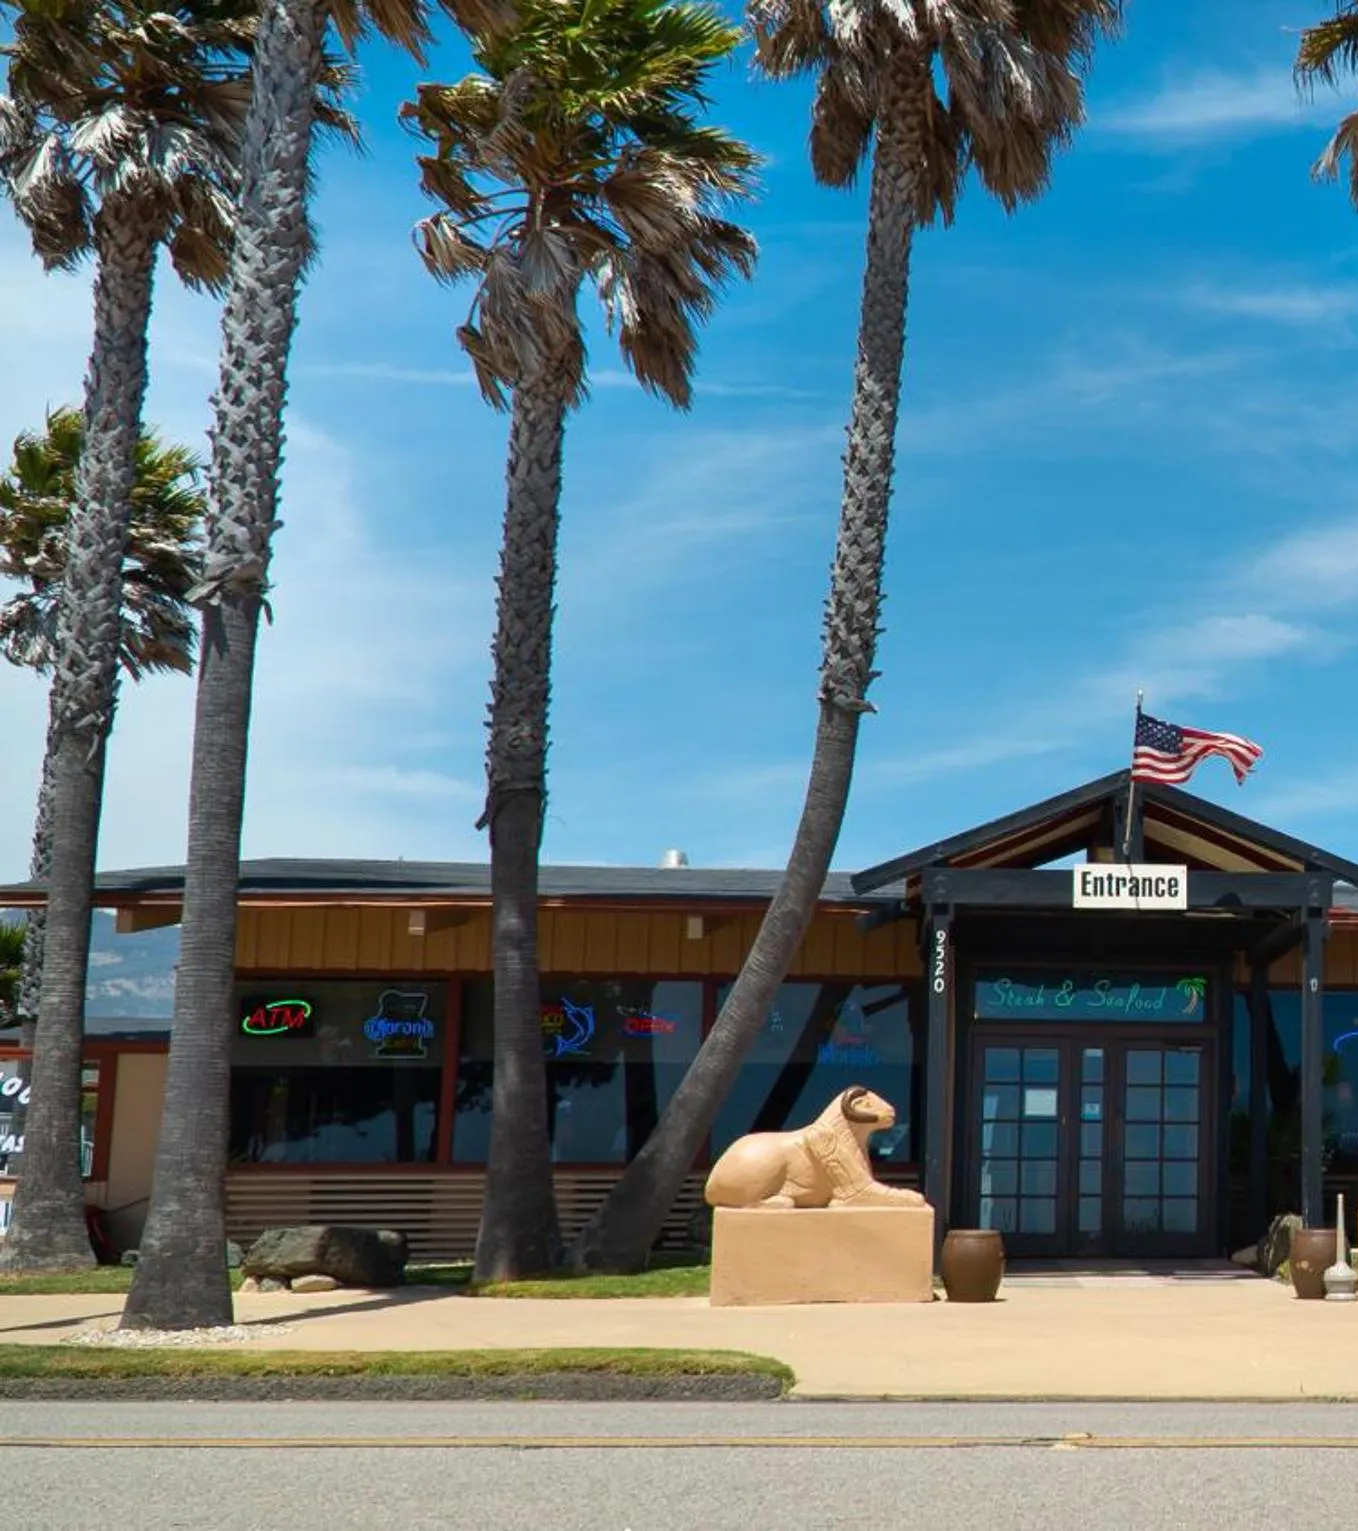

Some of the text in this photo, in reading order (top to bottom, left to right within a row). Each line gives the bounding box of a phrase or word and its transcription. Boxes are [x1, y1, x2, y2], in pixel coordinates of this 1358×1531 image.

[1081, 871, 1179, 898] Entrance
[933, 930, 947, 993] 9520
[987, 977, 1166, 1013] Steak & Seafood
[250, 1007, 307, 1028] ATM
